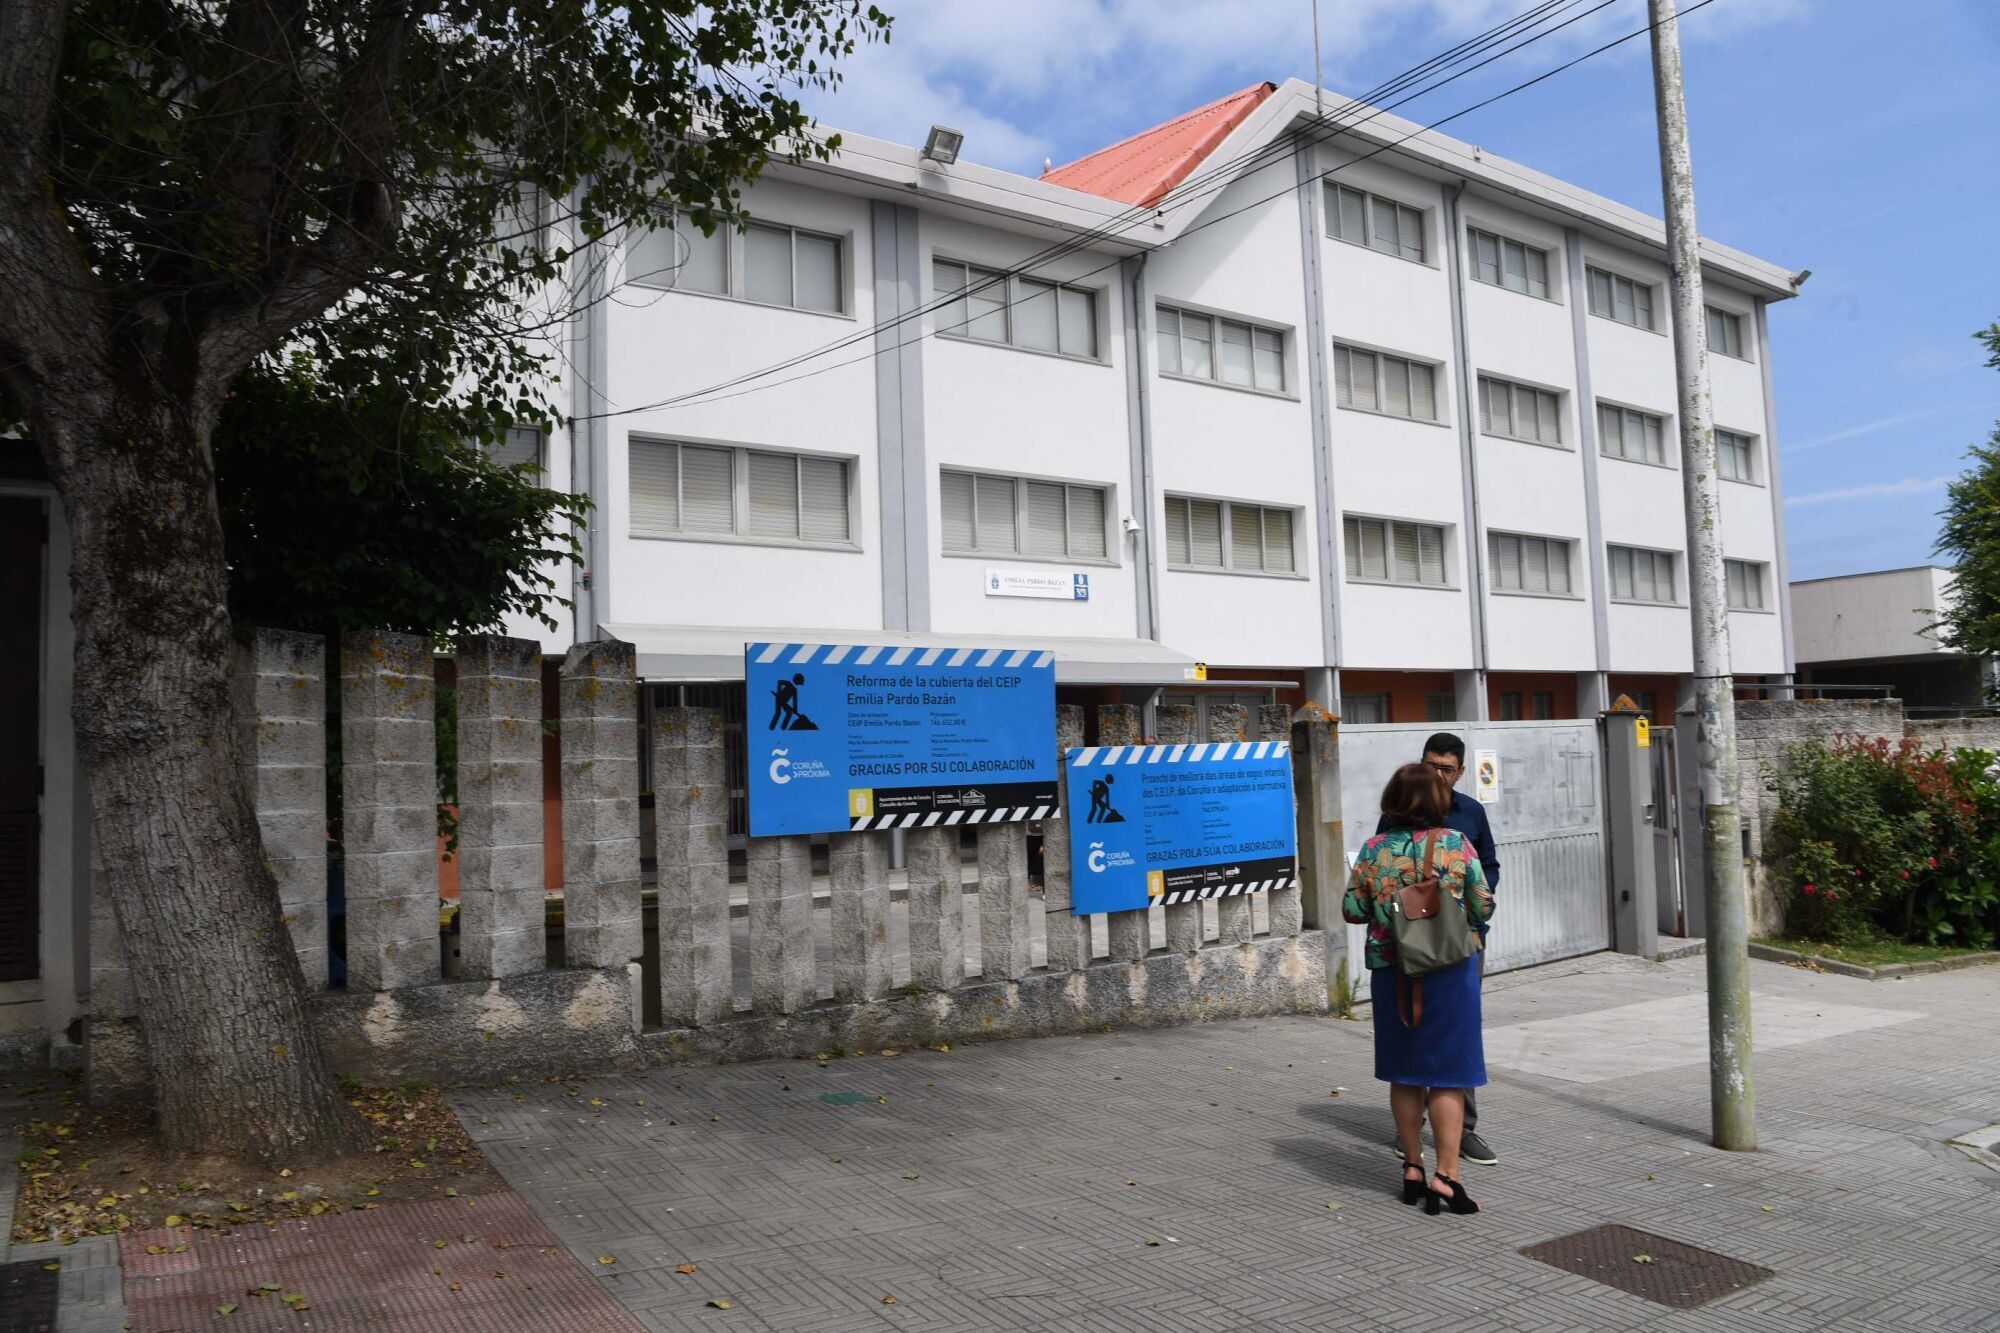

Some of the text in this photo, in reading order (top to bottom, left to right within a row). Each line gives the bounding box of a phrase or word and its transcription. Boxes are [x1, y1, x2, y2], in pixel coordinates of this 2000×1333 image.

[847, 675, 1021, 688] Reforma de la cubierta del CEIP
[847, 693, 956, 705] Emilia Pardo Bazán
[792, 760, 824, 770] CORUÑA
[849, 756, 1035, 777] GRACIAS POR SU COLABORACIÓN
[1170, 772, 1177, 782] de
[1205, 771, 1217, 781] das
[1238, 769, 1245, 779] de
[1143, 789, 1153, 798] dos
[1187, 784, 1211, 796] Coruña
[1146, 838, 1285, 863] GRAZAS POLA SÚA COLABORACIÓN
